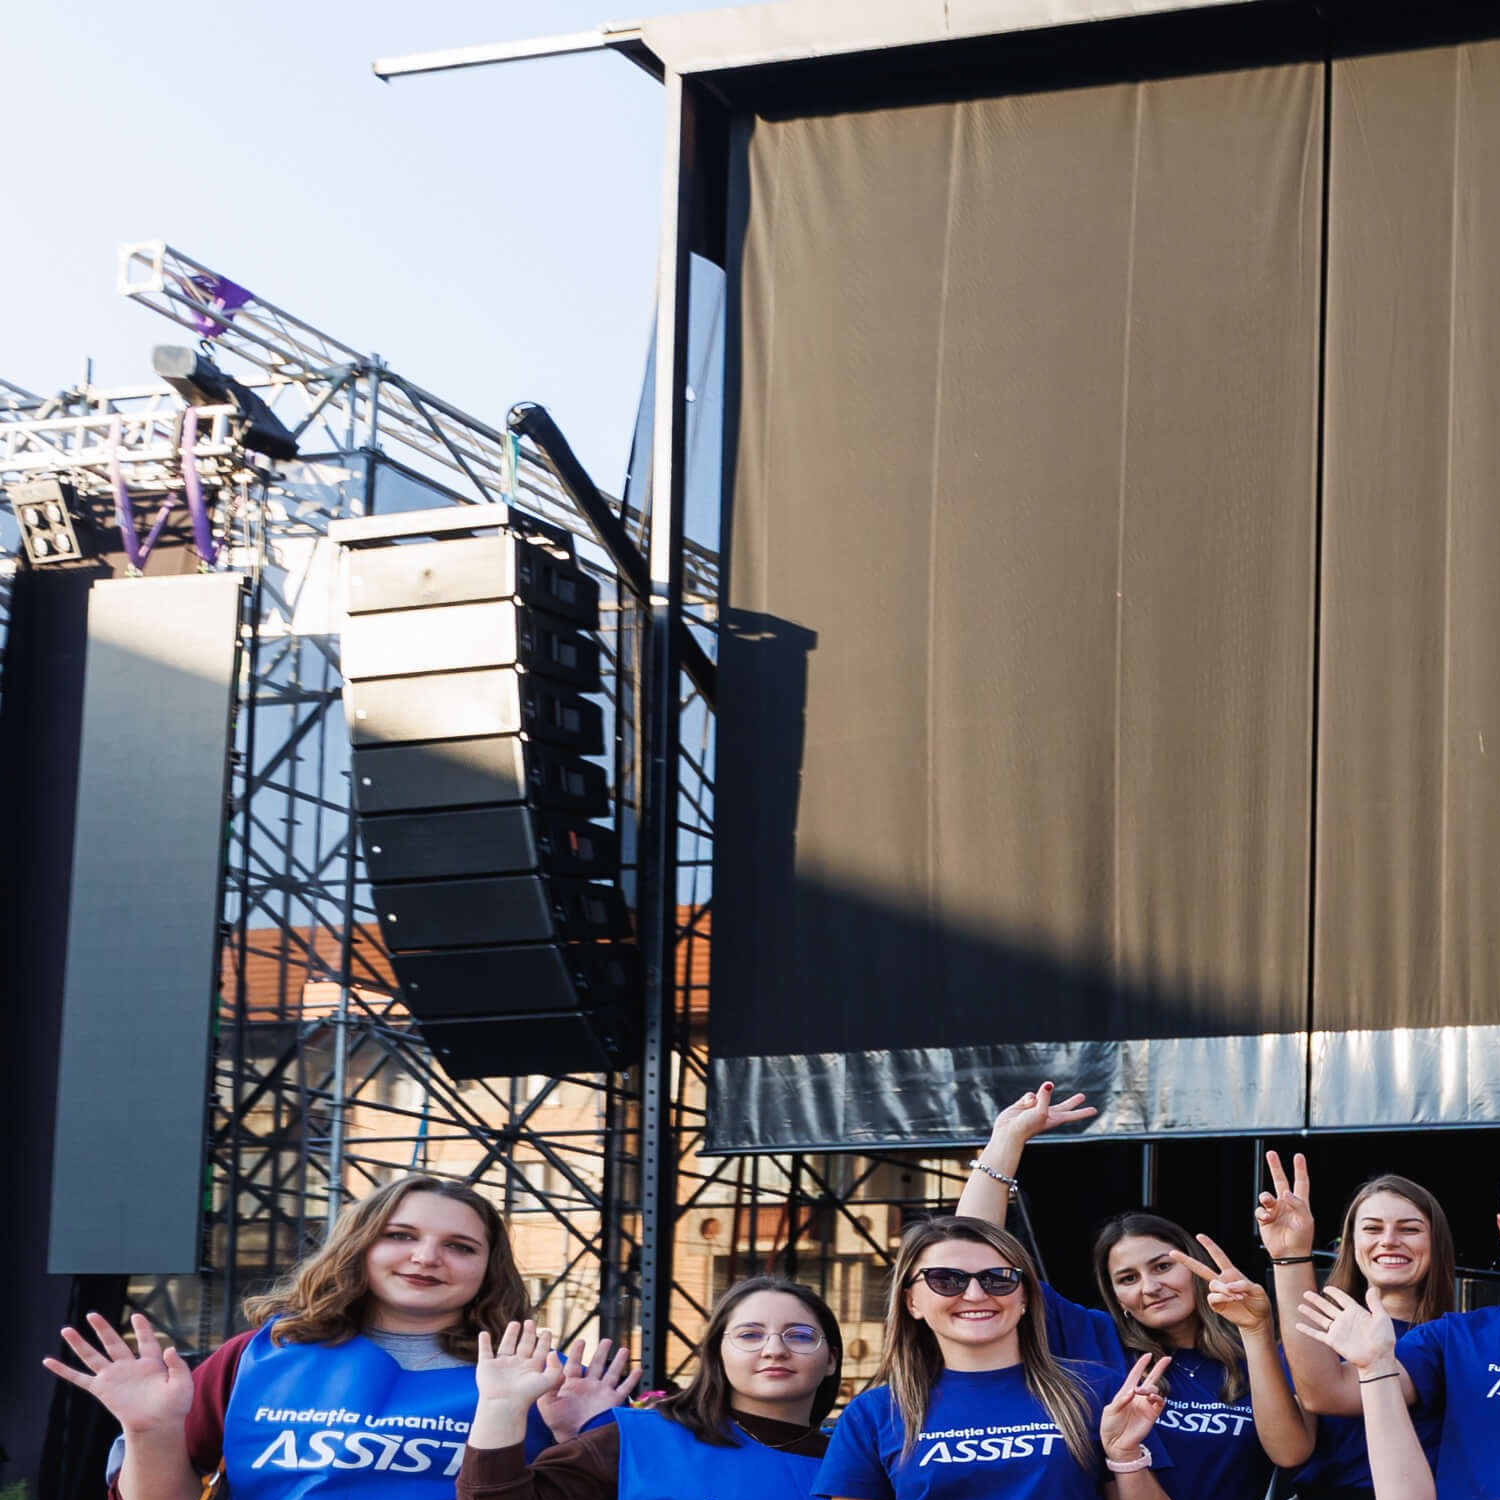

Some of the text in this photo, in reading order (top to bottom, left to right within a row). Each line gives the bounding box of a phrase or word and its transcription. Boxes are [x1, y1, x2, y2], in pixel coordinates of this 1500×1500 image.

[255, 1408, 360, 1427] Fundația
[1156, 1410, 1253, 1436] SSIST
[919, 1433, 1065, 1467] ASSIST
